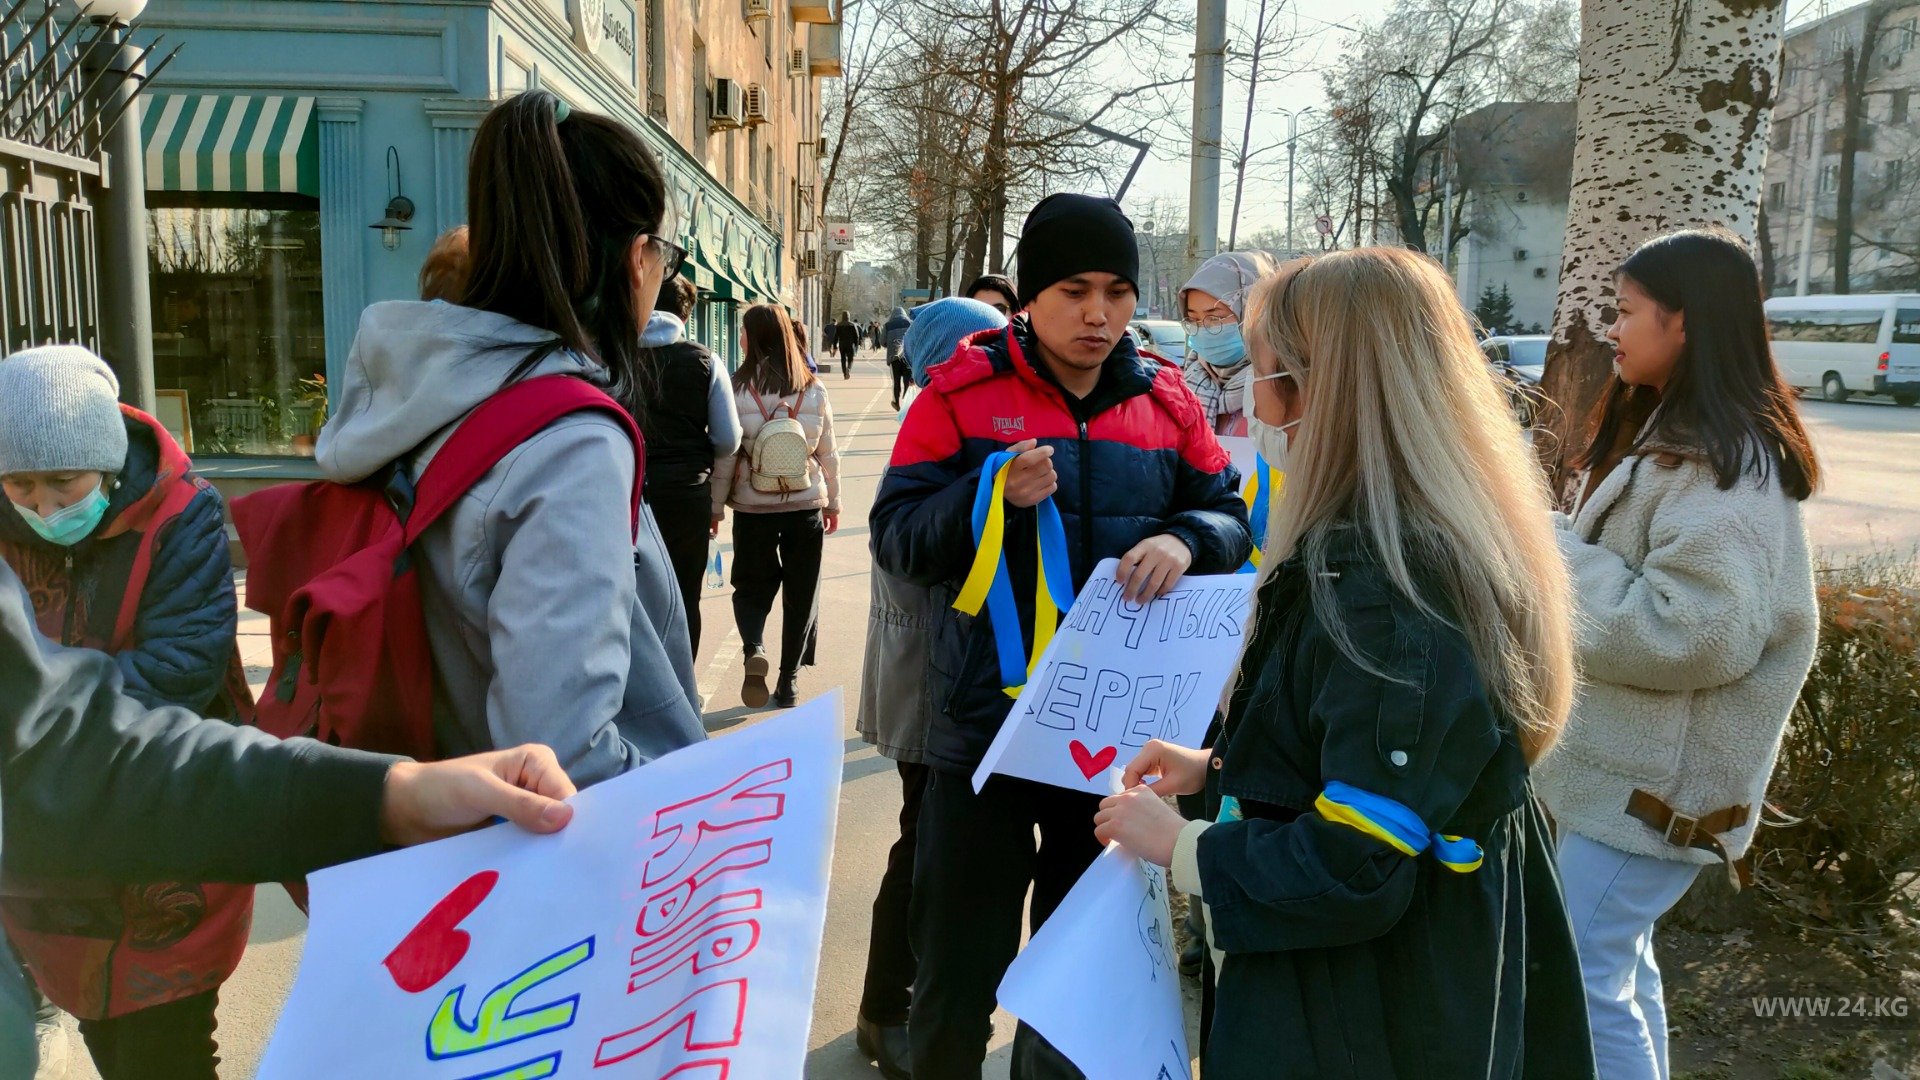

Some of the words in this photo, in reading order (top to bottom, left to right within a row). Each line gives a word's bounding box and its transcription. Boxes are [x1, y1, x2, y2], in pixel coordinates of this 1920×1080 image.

[992, 416, 1025, 432] EVERLAST
[1025, 661, 1201, 747] ЕРЕК
[594, 758, 792, 1080] КЫРГ
